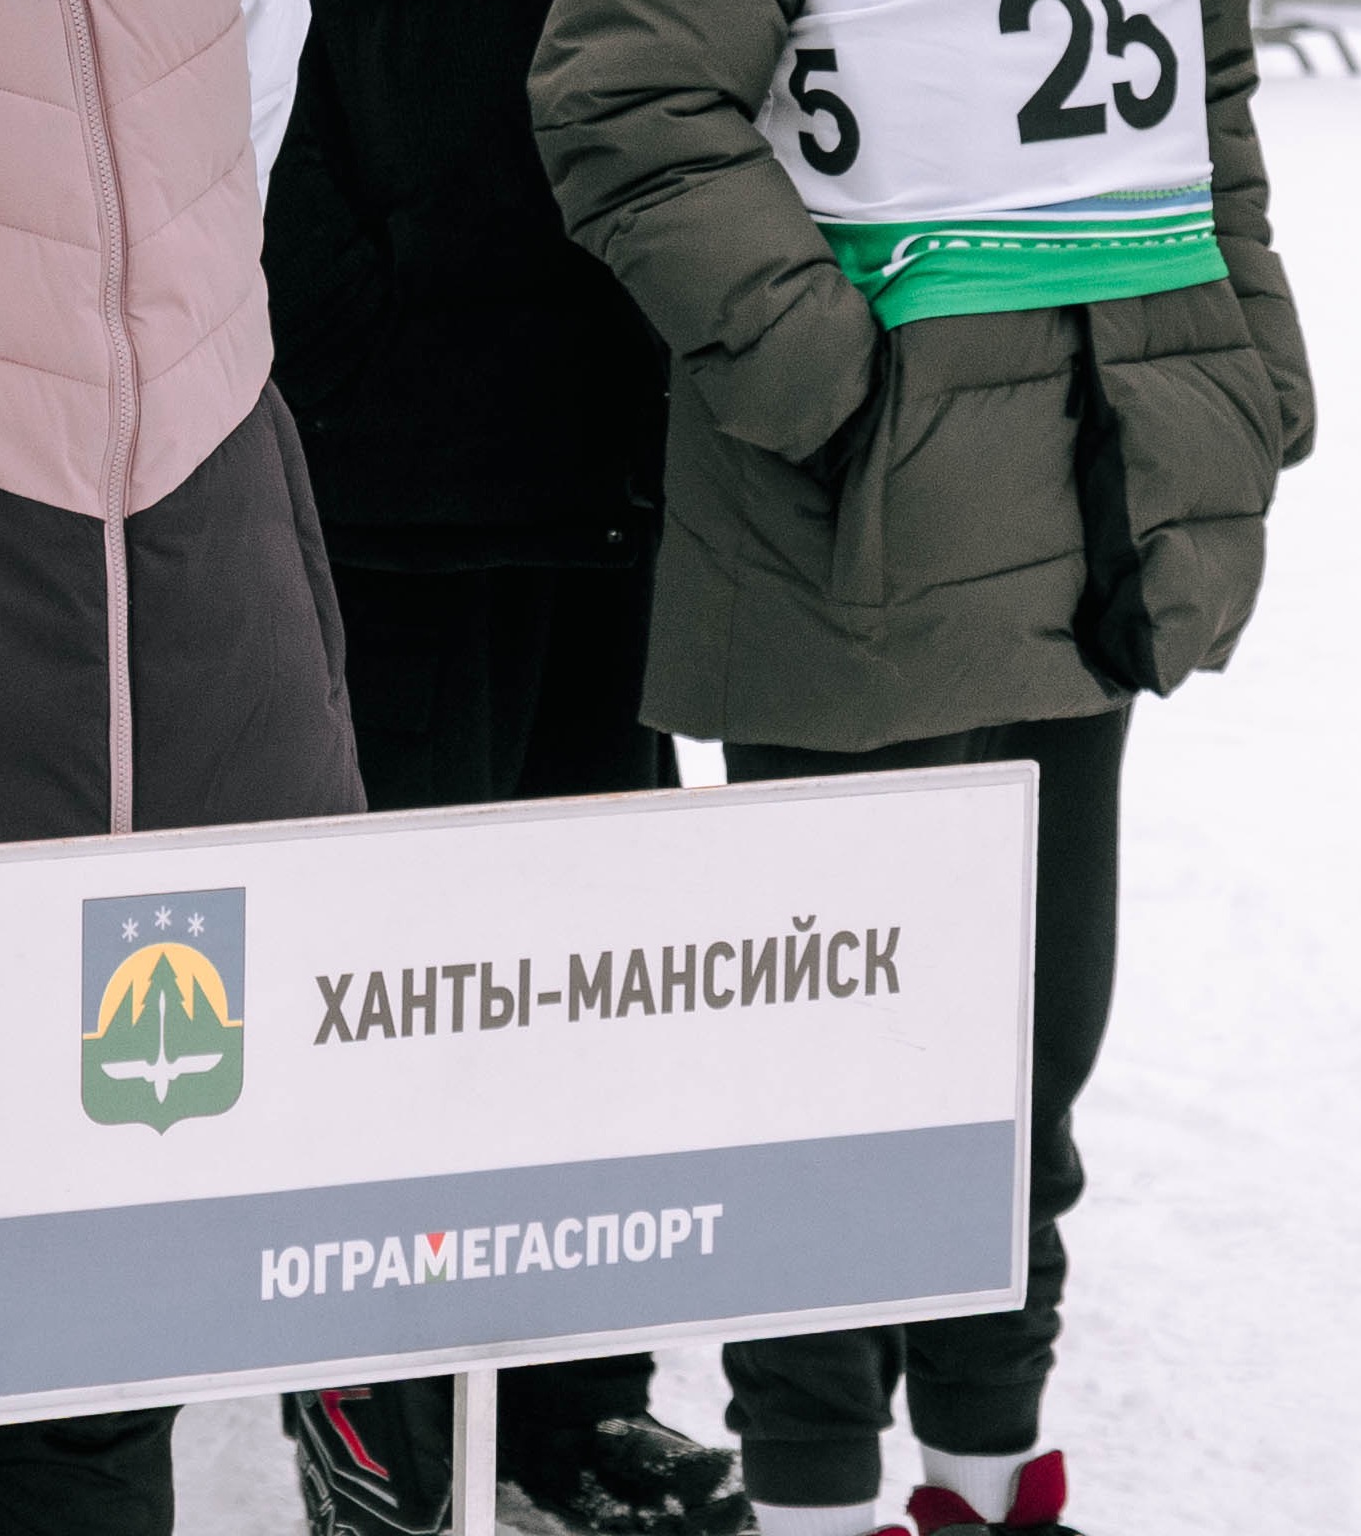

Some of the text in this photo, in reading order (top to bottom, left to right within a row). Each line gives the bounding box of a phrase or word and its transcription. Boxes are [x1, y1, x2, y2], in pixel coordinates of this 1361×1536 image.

[788, 47, 861, 177] 5
[312, 914, 902, 1046] ХАНТЫ-МАНСИЙСК
[260, 1203, 725, 1301] ЮГРАМЕГАСПОРТ
